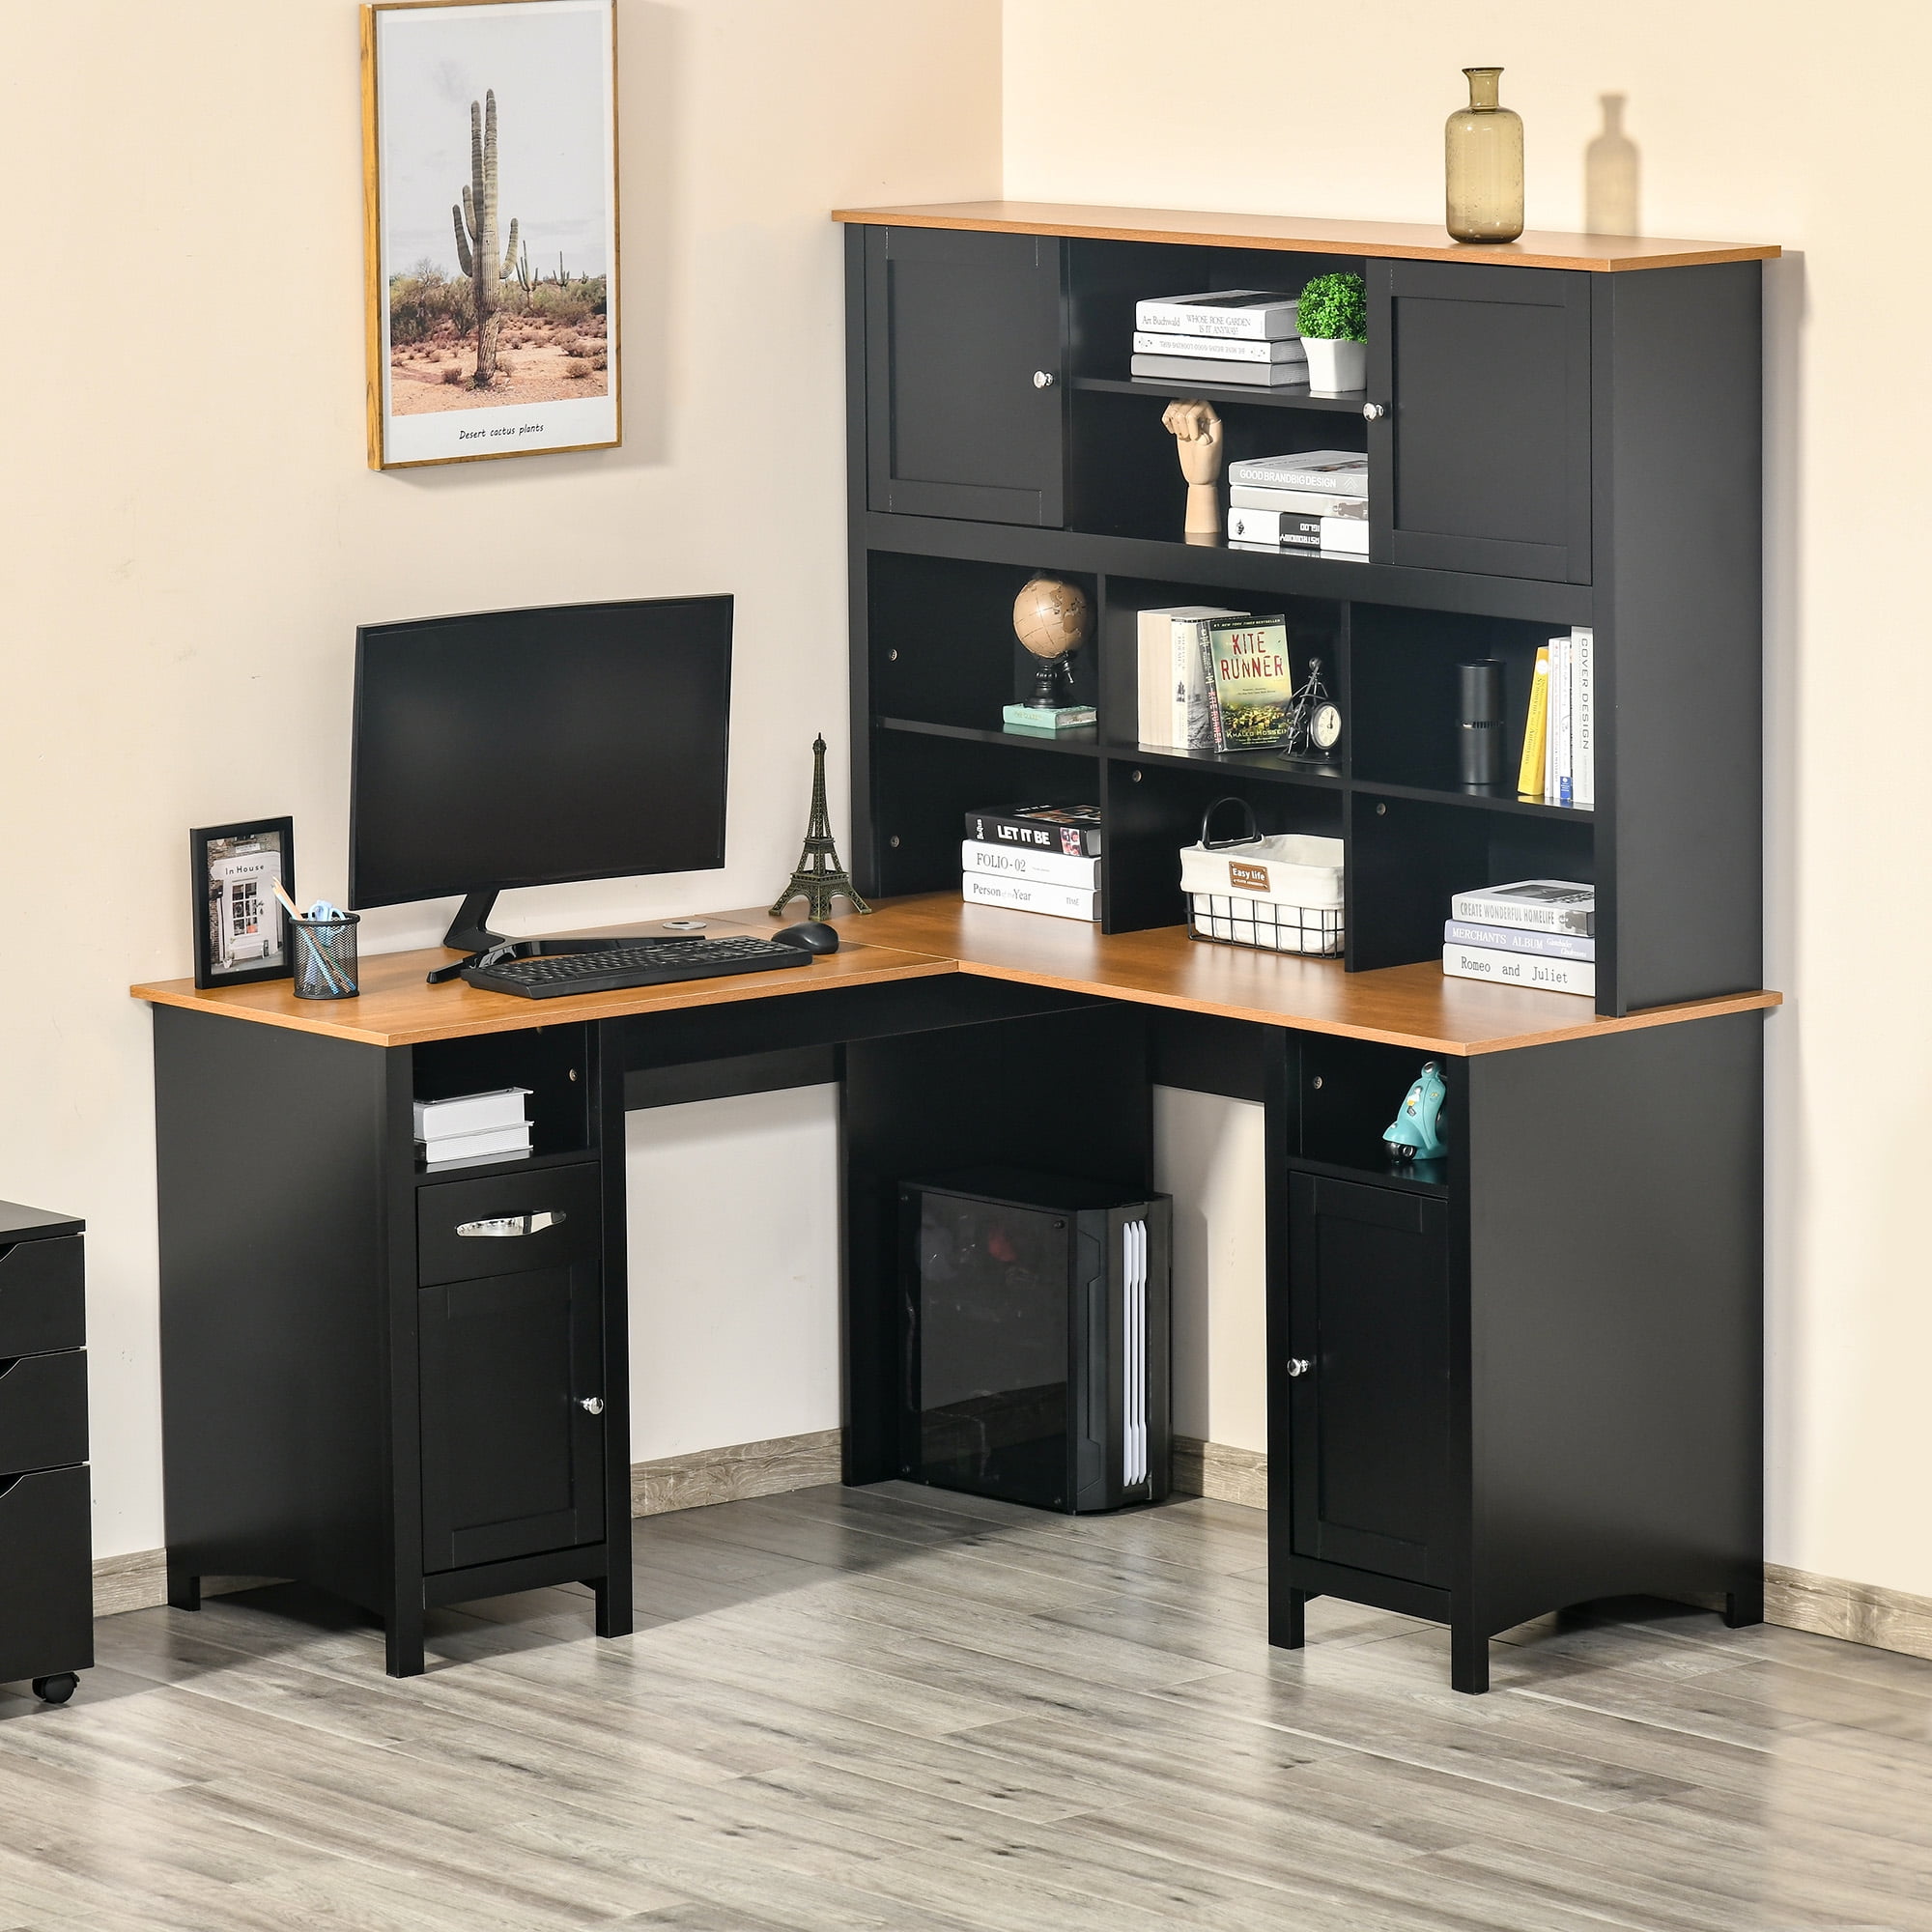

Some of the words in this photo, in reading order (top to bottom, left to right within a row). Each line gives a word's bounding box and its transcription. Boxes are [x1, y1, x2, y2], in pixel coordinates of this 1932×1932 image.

[1142, 315, 1151, 325] Art
[1152, 315, 1180, 327] Buchwald
[1186, 314, 1208, 325] WHOSE
[1209, 315, 1224, 325] ROSE
[1225, 316, 1252, 327] GARDEN
[1199, 325, 1205, 333] IS
[459, 429, 486, 440] Desert
[490, 427, 516, 437] cactus
[519, 424, 544, 436] plants
[1232, 631, 1266, 655] KITE
[1220, 655, 1284, 681] RUNNER
[997, 825, 1019, 840] LET
[1020, 827, 1033, 842] IT
[1034, 830, 1051, 845] BE
[236, 865, 265, 874] House
[1232, 867, 1251, 880] Easy
[1251, 870, 1265, 881] life
[973, 883, 1002, 897] Person
[1013, 889, 1032, 901] Year
[1460, 901, 1483, 918] CREATE
[1483, 904, 1523, 923] WONDERFUL
[1523, 908, 1554, 925] HOMELIFE
[1452, 927, 1507, 945] MERCHANTS
[1512, 936, 1544, 950] ALBUM
[1461, 955, 1492, 973] Romeo
[1502, 964, 1520, 977] and
[1531, 966, 1569, 983] Juliet
